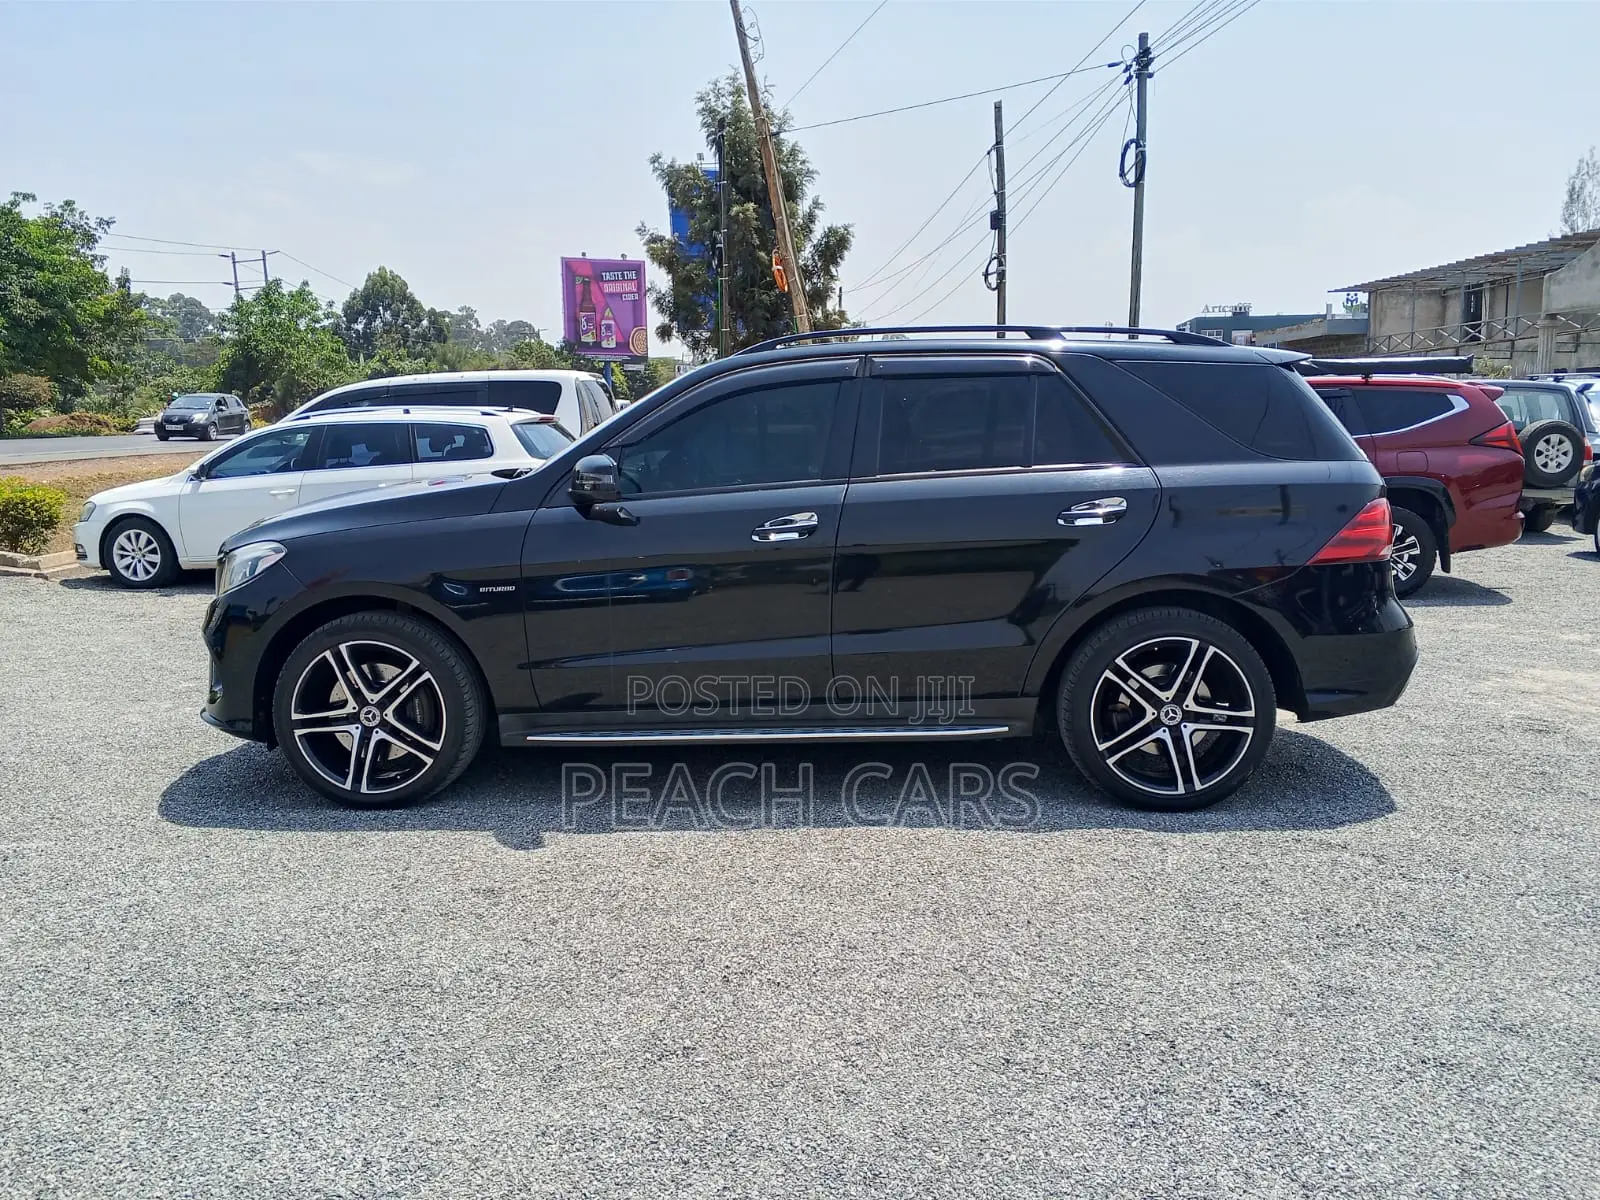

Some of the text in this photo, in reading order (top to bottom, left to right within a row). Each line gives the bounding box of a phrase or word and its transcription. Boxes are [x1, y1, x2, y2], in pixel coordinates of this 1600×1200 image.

[601, 271, 637, 280] TASTE THE
[603, 282, 637, 293] ORIGINAL
[622, 293, 639, 301] CIDER
